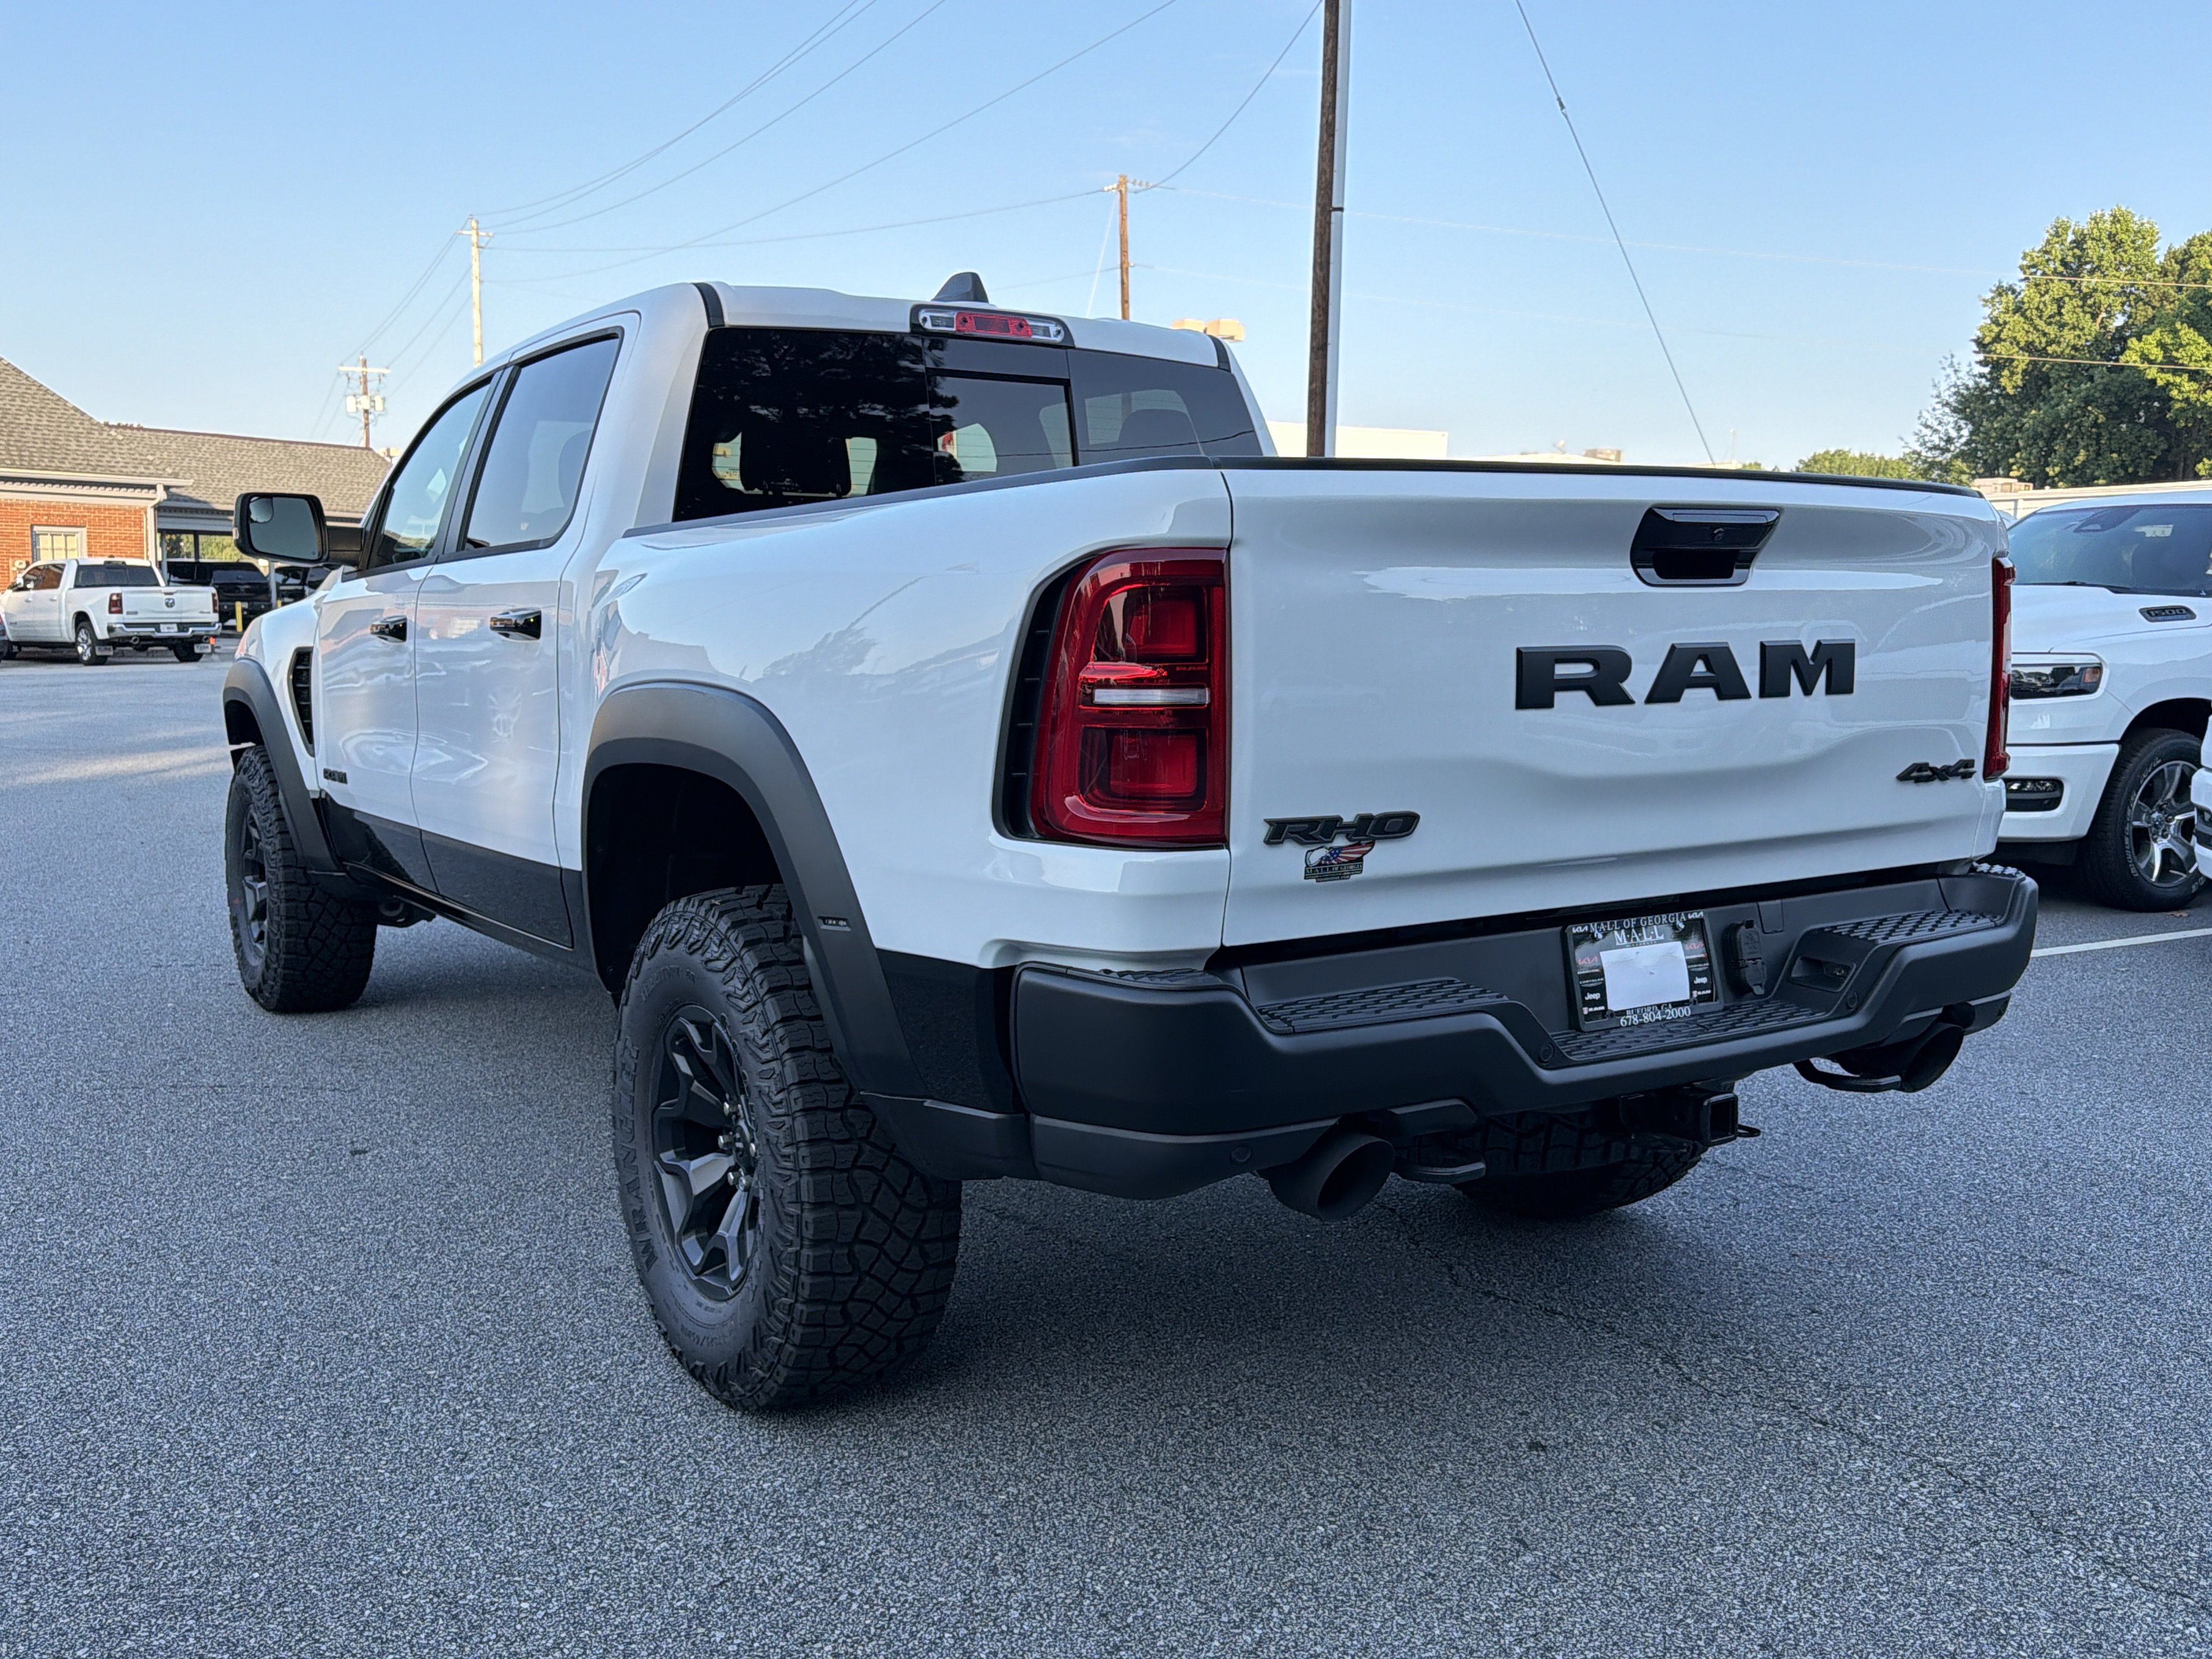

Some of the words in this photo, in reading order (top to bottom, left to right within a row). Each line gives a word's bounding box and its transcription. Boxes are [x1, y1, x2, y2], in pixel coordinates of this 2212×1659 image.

[1515, 639, 1855, 710] RAM
[1895, 759, 1977, 783] 4x4
[1263, 811, 1420, 845] RHO
[1623, 917, 1637, 929] OF
[1640, 912, 1686, 926] GEORGIA
[1584, 992, 1601, 1001] Jeep
[1620, 1006, 1691, 1028] 678-804-2000
[618, 1036, 658, 1273] WRANGLER
